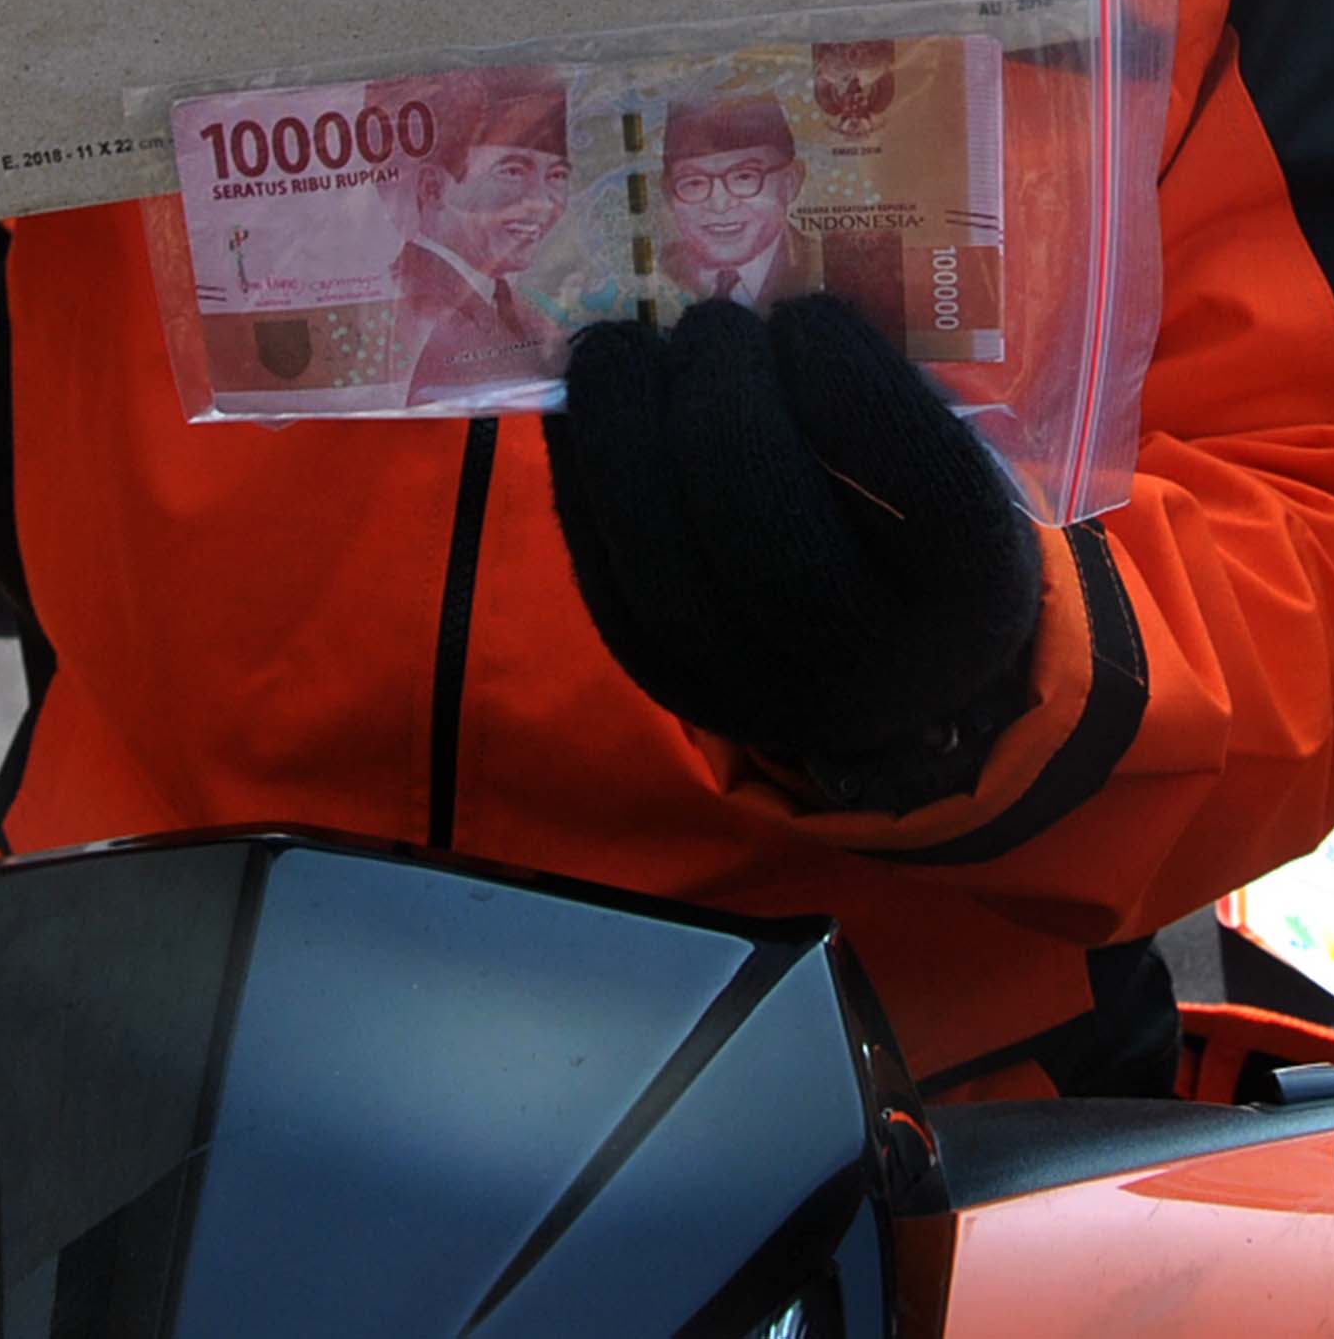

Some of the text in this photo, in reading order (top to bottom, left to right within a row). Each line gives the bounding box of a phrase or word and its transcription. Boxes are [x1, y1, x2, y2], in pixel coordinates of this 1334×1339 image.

[76, 143, 93, 160] 11
[115, 138, 134, 154] 22
[200, 100, 434, 180] 100000
[212, 167, 399, 201] SERATUS RIBU RUPIAH
[801, 213, 920, 232] INDONESIA
[932, 244, 960, 330] 100000
